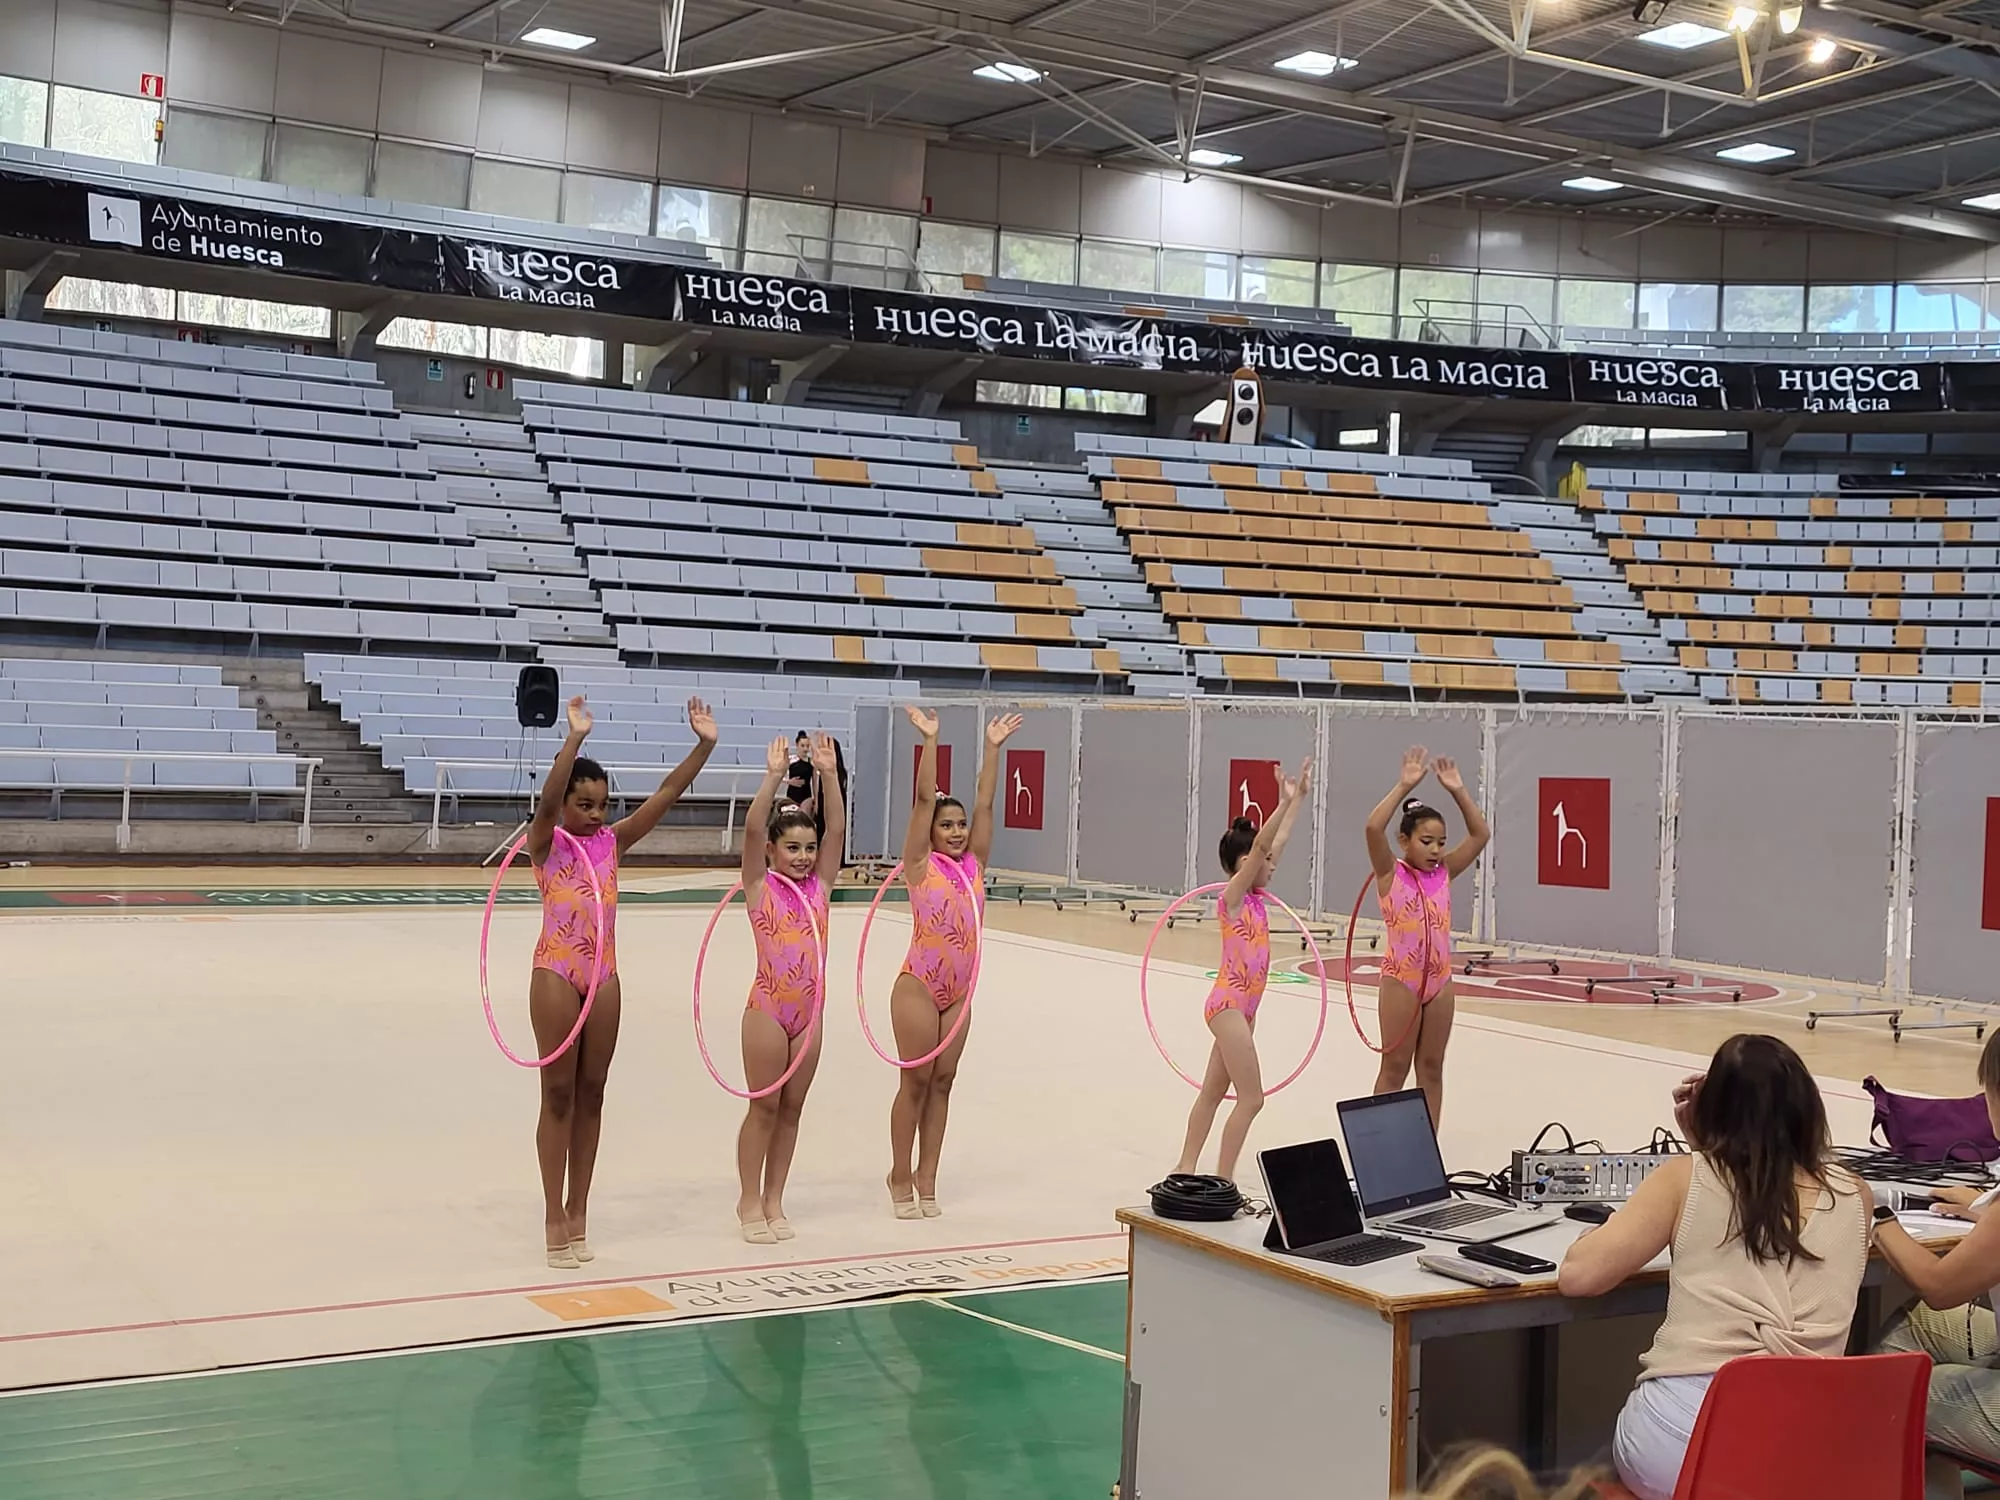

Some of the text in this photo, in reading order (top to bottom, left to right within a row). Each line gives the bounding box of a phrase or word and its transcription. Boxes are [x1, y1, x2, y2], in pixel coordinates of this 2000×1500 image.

[151, 203, 323, 246] Ayuntamiento
[152, 231, 284, 267] de Huesca
[464, 246, 622, 290] Huesca
[685, 273, 831, 314] Huesca
[874, 305, 1026, 345] Huesca
[1241, 342, 1381, 378] Huesca
[1588, 359, 1721, 388] Huesca
[1778, 366, 1921, 392] Huesca
[667, 1254, 1014, 1294] Ayuntamiento
[688, 1294, 752, 1307] de
[763, 1274, 967, 1298] Huesca
